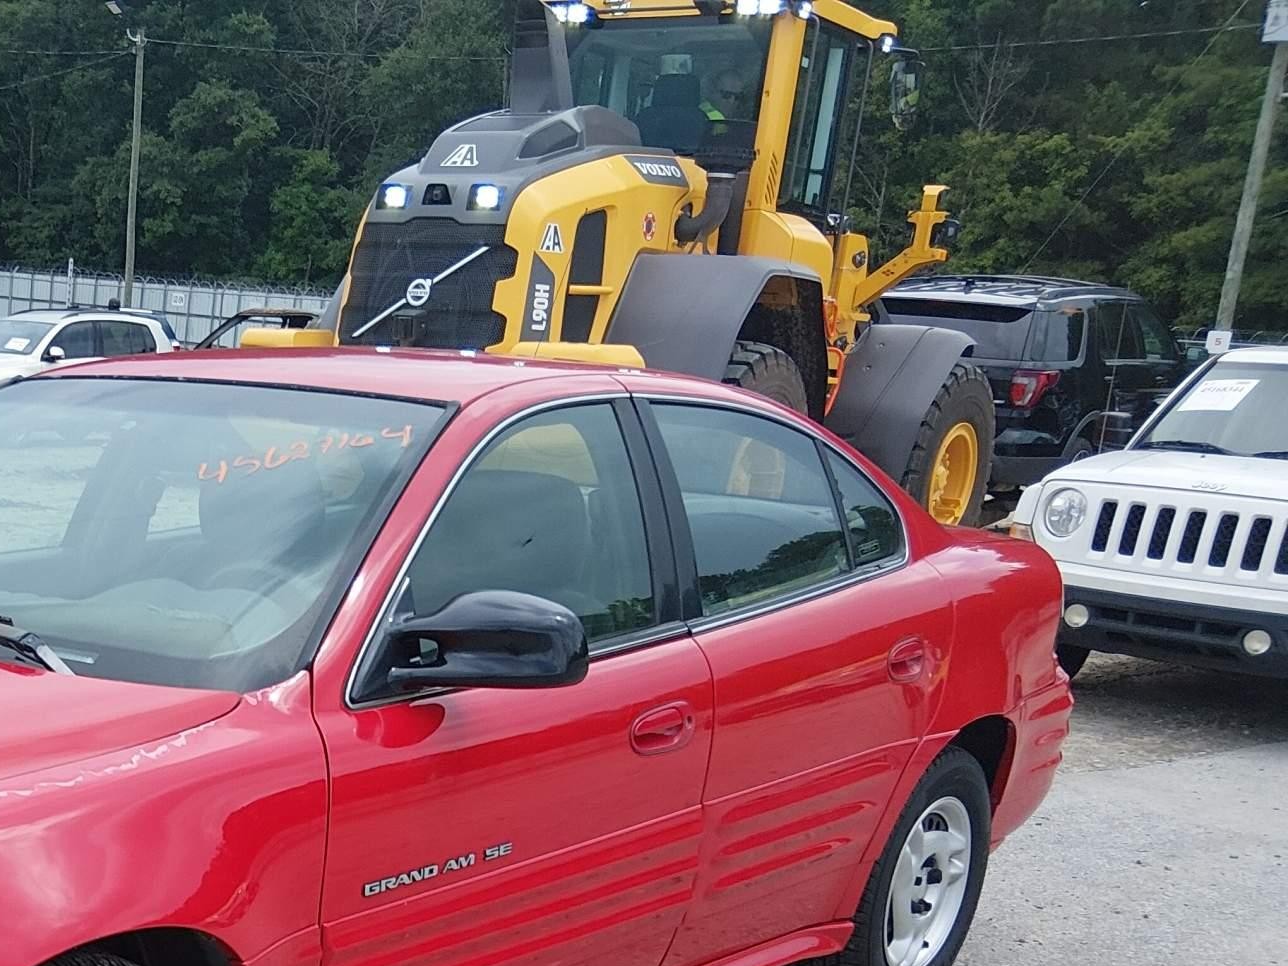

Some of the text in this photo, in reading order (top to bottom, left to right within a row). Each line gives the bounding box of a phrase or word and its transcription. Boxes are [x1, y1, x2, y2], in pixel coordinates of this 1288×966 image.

[634, 161, 682, 178] VOLVO
[531, 283, 550, 331] L90H
[1215, 338, 1222, 346] 5
[362, 842, 513, 897] GRAND AM SE
